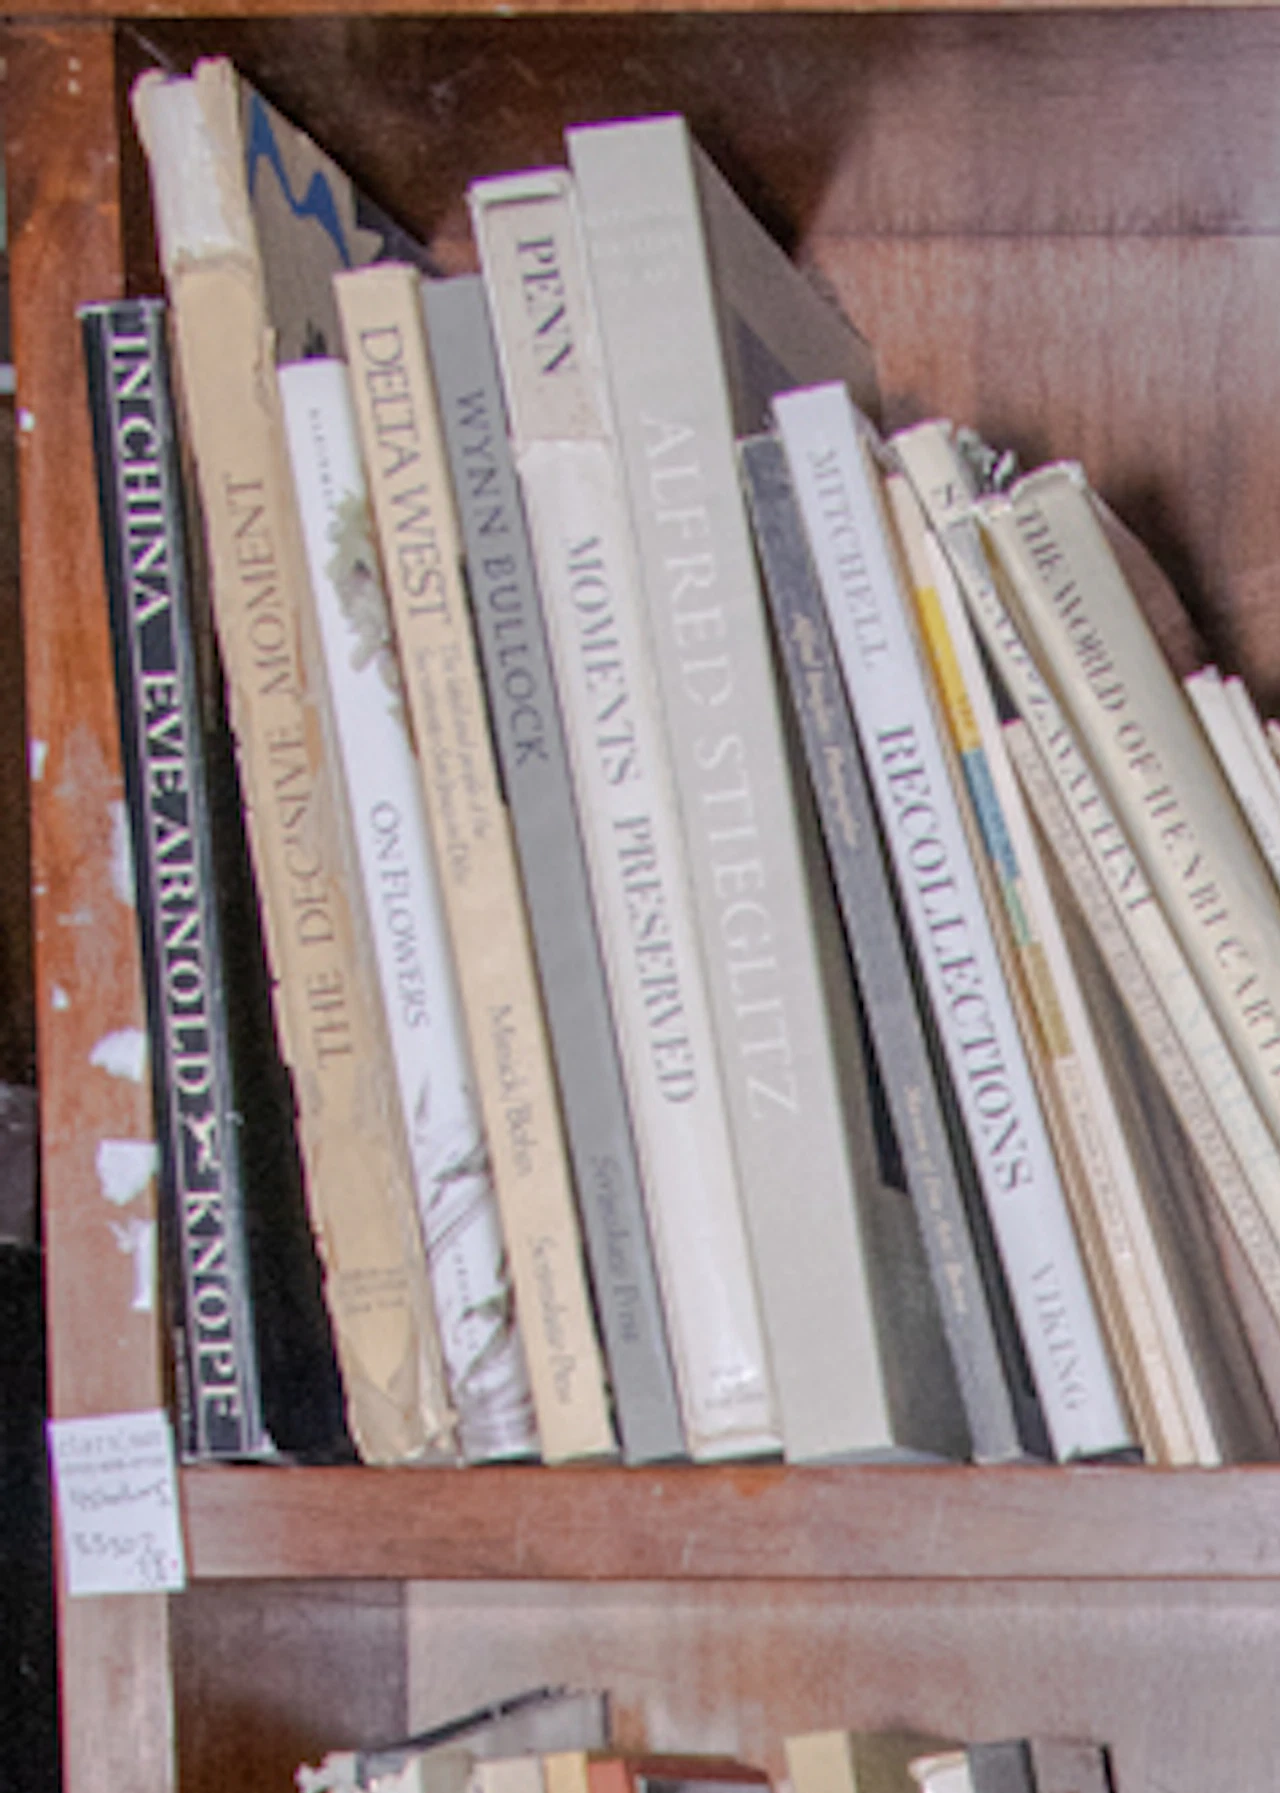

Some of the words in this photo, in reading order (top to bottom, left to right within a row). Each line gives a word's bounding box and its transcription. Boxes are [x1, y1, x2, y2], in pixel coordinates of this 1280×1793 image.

[108, 332, 154, 399] IN
[357, 323, 424, 479] DELTA
[447, 387, 512, 540] WYNN
[115, 415, 174, 626] CHINA
[221, 468, 301, 712] MOMENT
[387, 484, 451, 626] WEST
[633, 406, 742, 714] ALFRED
[137, 669, 189, 799] EVE
[475, 552, 551, 770] BULLOCK
[511, 232, 582, 382] PENN
[556, 531, 648, 791] MOMENTS
[606, 812, 705, 1110] PRESERVED
[1046, 579, 1136, 719] WORLD
[1108, 714, 1164, 782] OF
[1139, 779, 1235, 934] HENRI
[149, 807, 215, 1099] ARNOLD
[301, 967, 357, 1069] THE
[373, 865, 436, 1033] FLOWERS
[684, 730, 809, 1125] STIEGLITZ
[803, 444, 894, 670] MITCHELL
[871, 719, 1040, 1199] RECOLLECTIONS
[1019, 1255, 1093, 1416] VIKING
[183, 1190, 244, 1424] KNOPF
